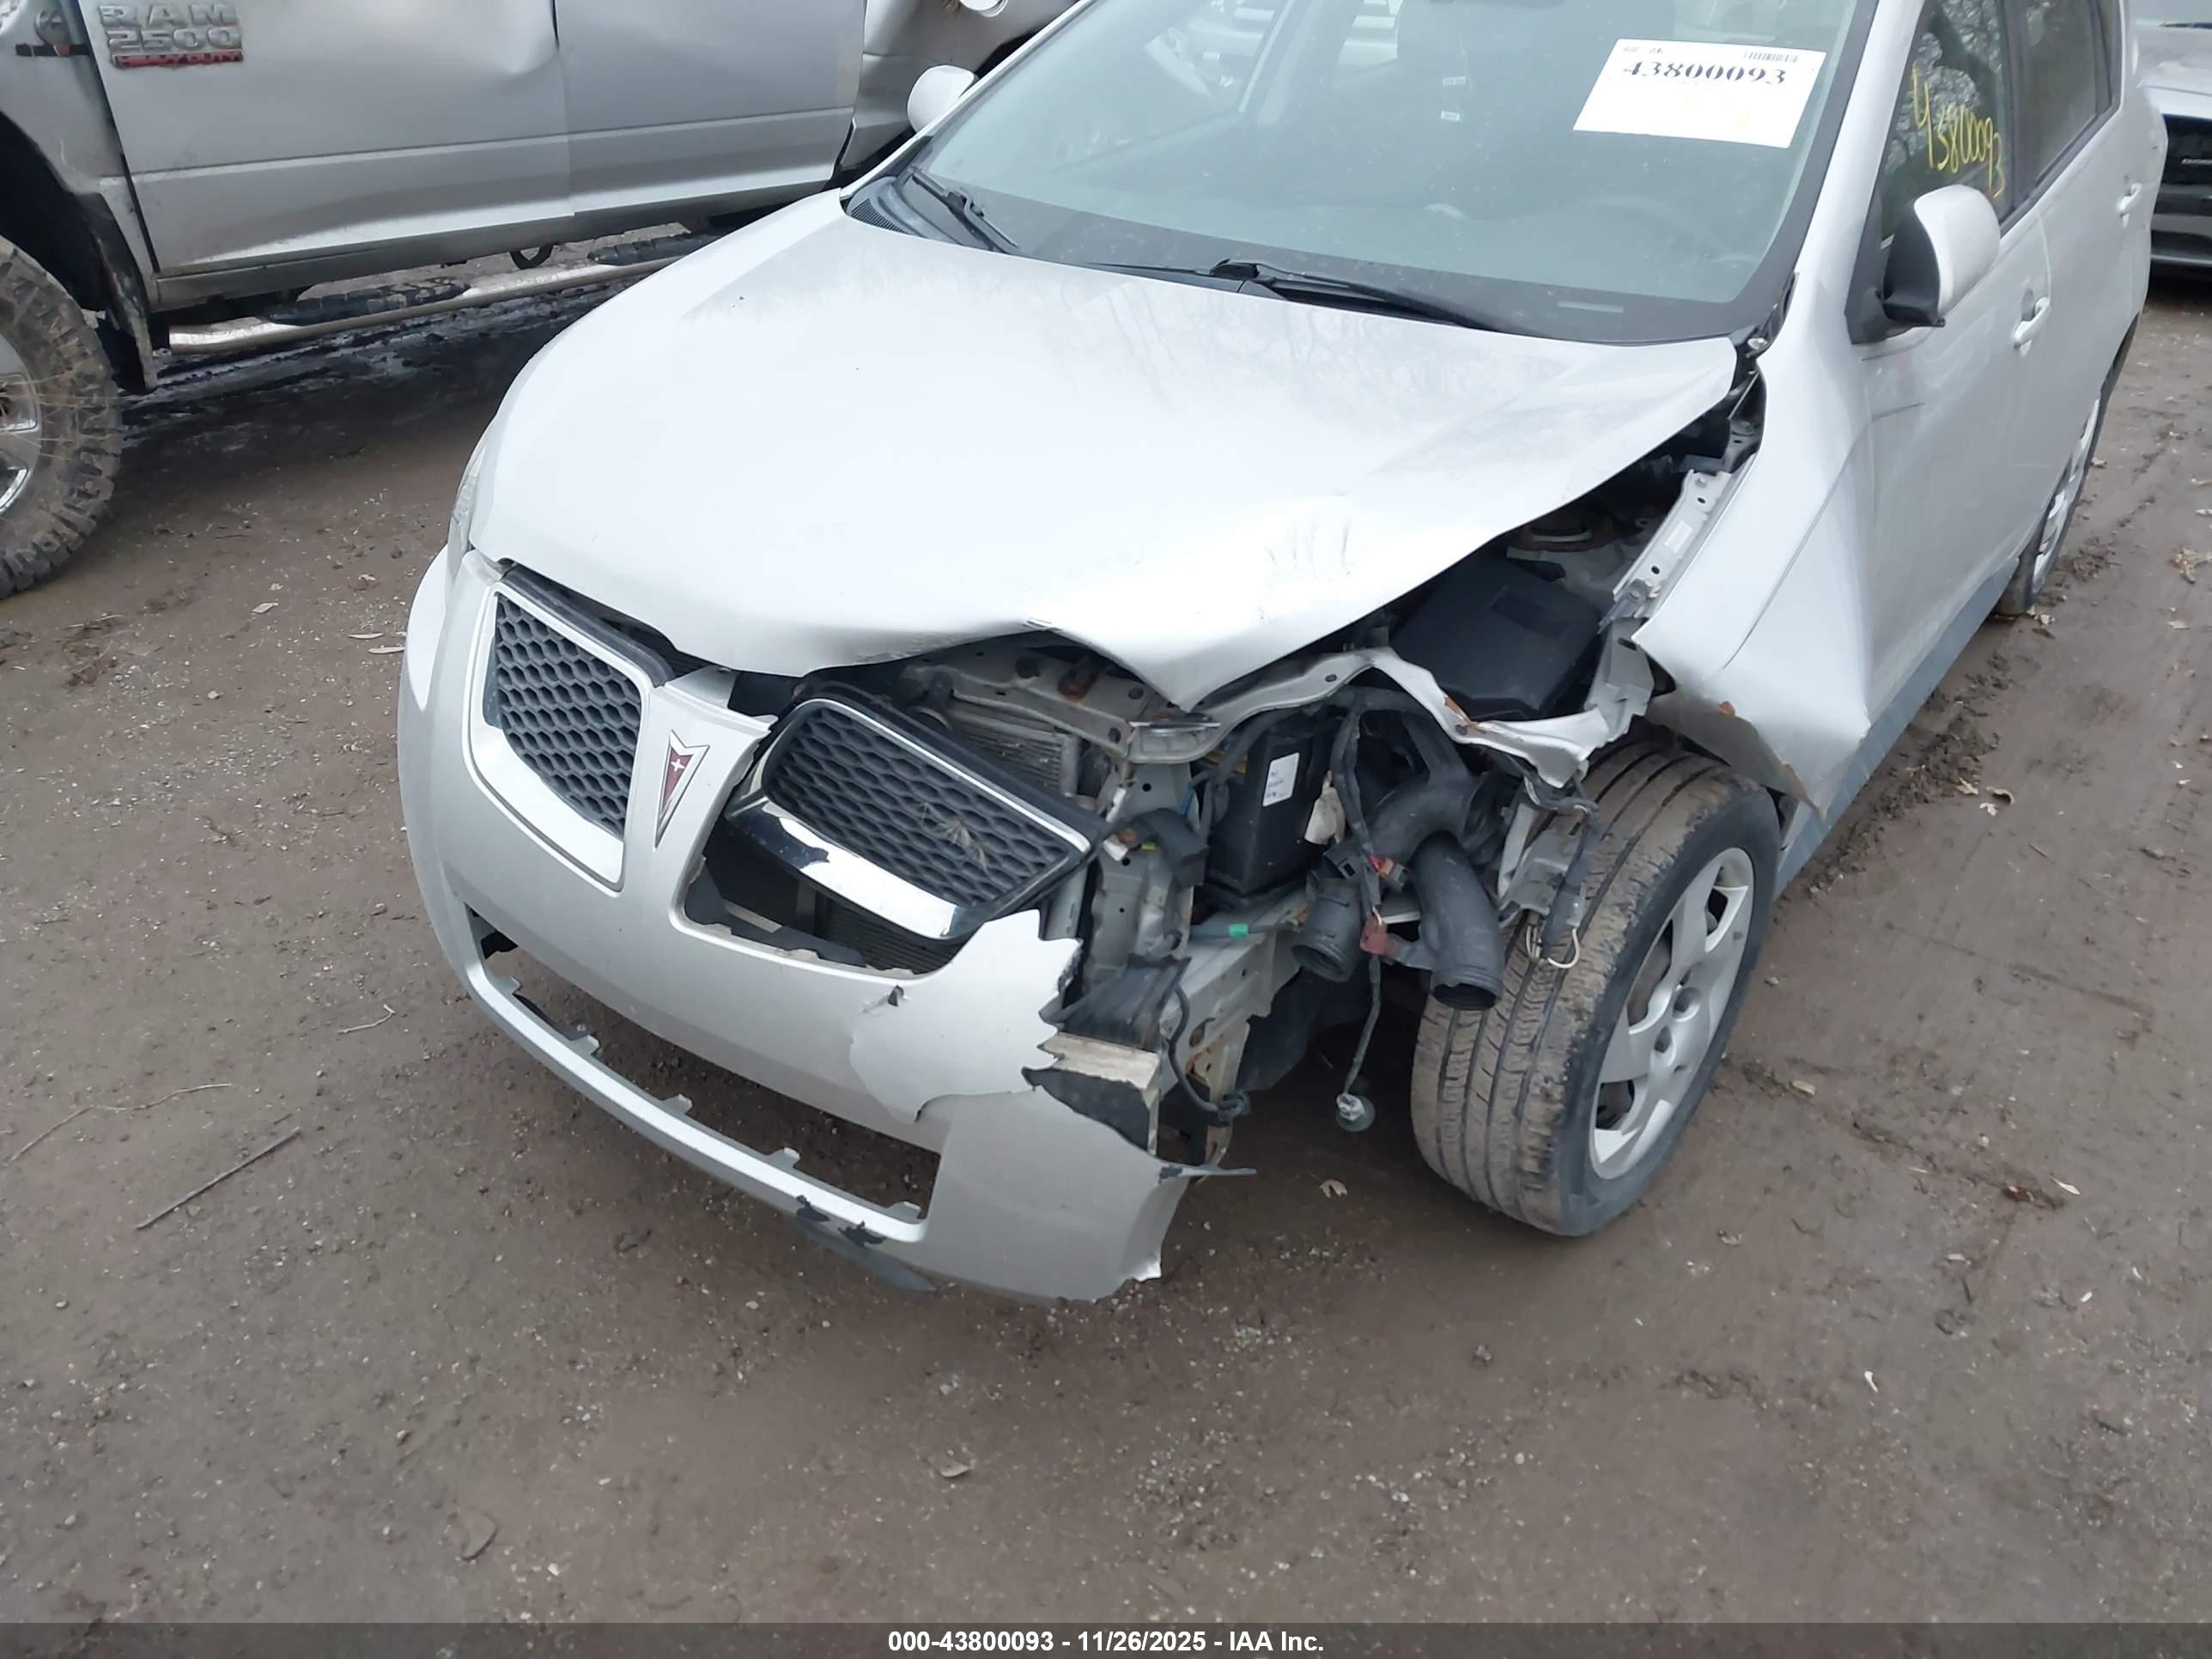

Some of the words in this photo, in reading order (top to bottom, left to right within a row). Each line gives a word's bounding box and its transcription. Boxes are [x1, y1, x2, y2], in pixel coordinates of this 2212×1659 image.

[98, 3, 238, 27] RAM
[106, 27, 244, 51] 2500
[1623, 60, 1787, 84] 43800093
